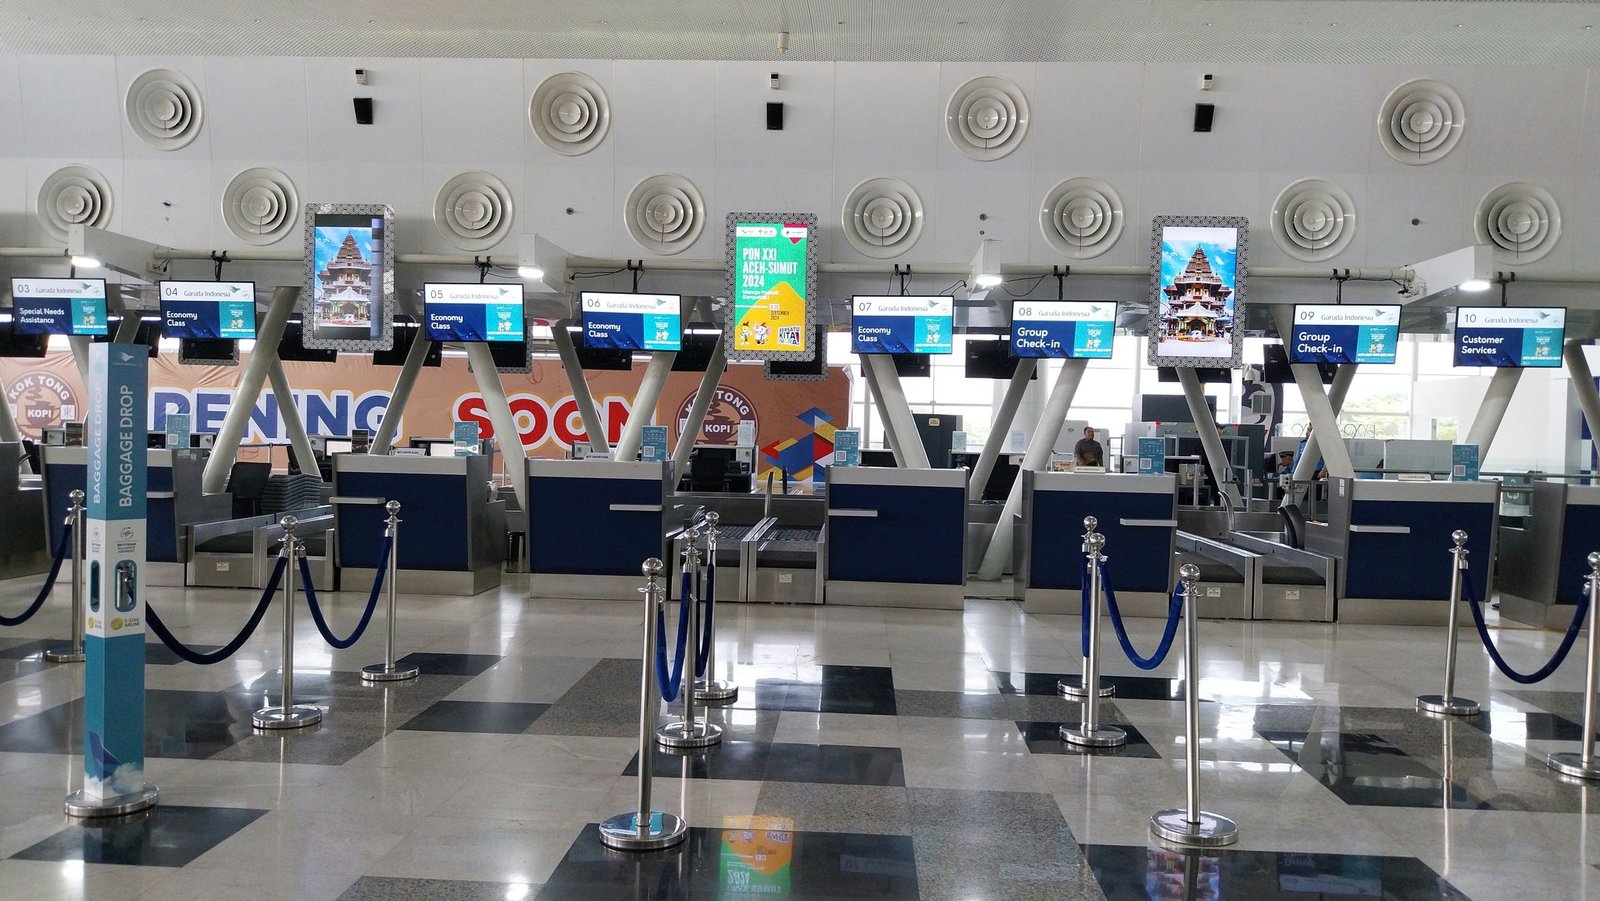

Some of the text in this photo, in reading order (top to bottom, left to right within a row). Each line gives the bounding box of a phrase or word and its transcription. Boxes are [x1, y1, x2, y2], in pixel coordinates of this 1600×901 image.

[742, 247, 777, 260] PON XXI
[742, 261, 798, 274] ACEH-SUMUT
[742, 275, 765, 287] 2024
[17, 284, 30, 294] 03
[165, 287, 178, 296] 04
[430, 290, 444, 299] 05
[587, 298, 601, 308] 06
[858, 302, 872, 311] 07
[19, 308, 65, 316] Special Needs
[166, 310, 198, 320] Economy
[1018, 307, 1032, 316] 08
[1300, 311, 1315, 320] 09
[20, 316, 55, 324] Assistance
[430, 313, 464, 323] Economy
[1465, 313, 1477, 323] 10
[167, 319, 186, 327] Class
[431, 322, 451, 330] Class
[588, 322, 621, 331] Economy
[588, 330, 609, 338] Class
[858, 326, 891, 335] Economy
[1017, 327, 1049, 338] Group
[858, 334, 878, 342] Class
[1298, 332, 1331, 343] Group
[1462, 335, 1504, 344] Customer
[1016, 339, 1060, 348] Check-in
[1297, 343, 1343, 353] Check-in
[1461, 346, 1497, 354] Services
[9, 375, 70, 400] KOK TONG
[716, 390, 750, 416] TONG
[27, 409, 52, 418] KOPI
[705, 424, 731, 433] KOPI
[119, 385, 134, 507] BAGGAGE DROP
[93, 429, 102, 504] BAGGAGE
